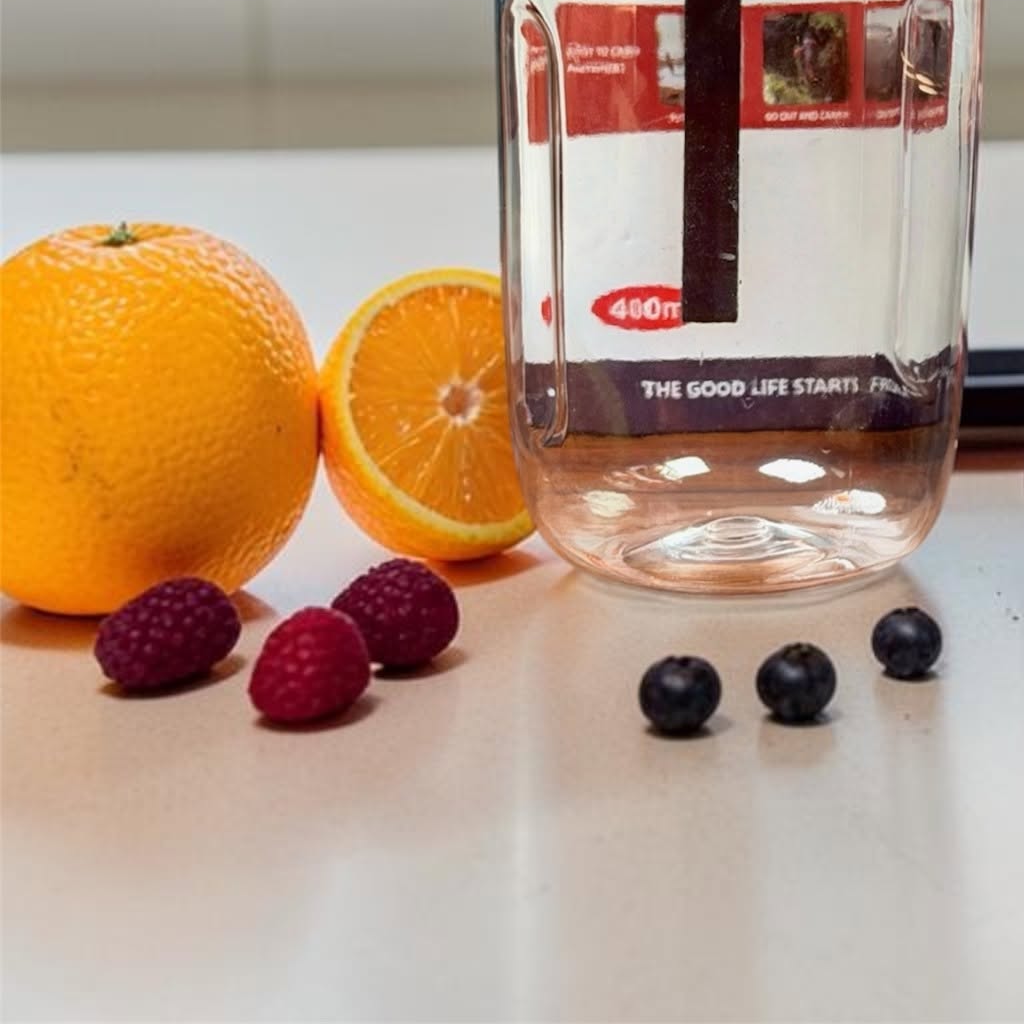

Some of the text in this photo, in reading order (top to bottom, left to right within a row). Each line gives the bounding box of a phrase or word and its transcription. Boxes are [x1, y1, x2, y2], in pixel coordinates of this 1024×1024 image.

[641, 379, 682, 400] THE
[686, 379, 746, 399] GOOD
[750, 376, 790, 397] LIFE
